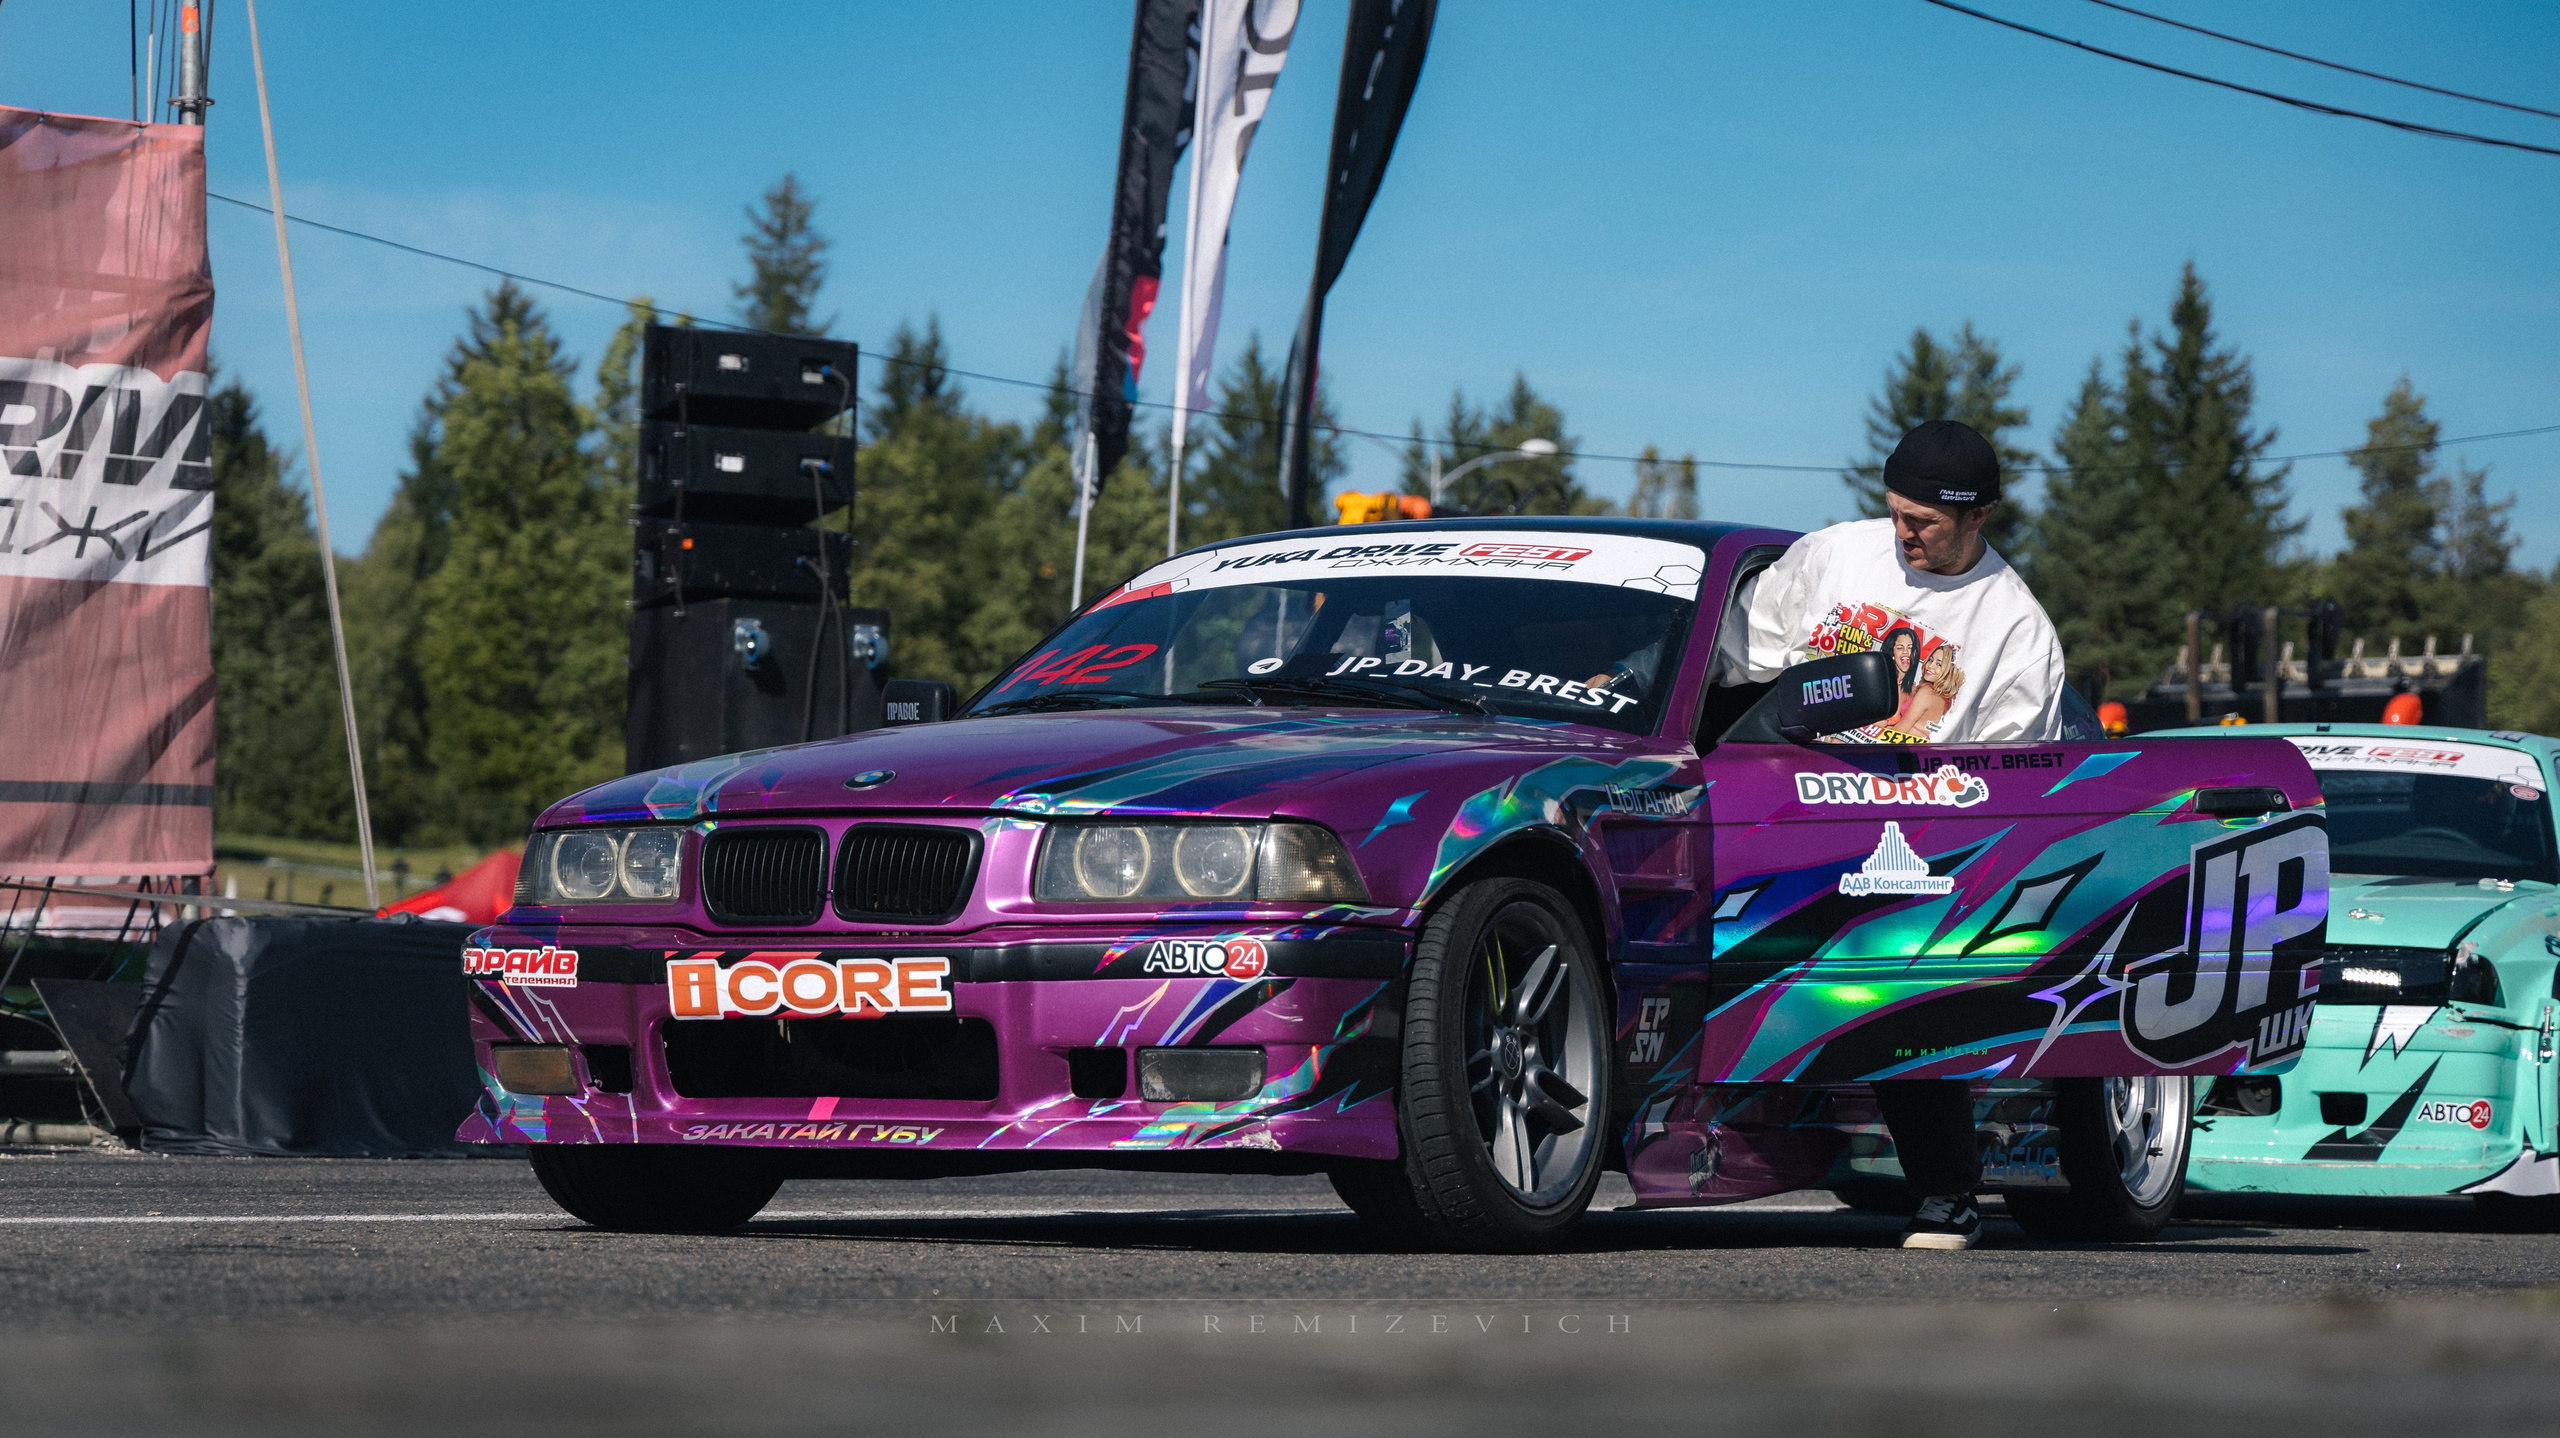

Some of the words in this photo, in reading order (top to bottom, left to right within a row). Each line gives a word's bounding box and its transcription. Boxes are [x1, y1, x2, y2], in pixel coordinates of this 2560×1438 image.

[1209, 549, 1326, 573] YUKA
[1315, 544, 1461, 560] DRIVE
[1463, 544, 1591, 561] FEST
[1839, 624, 1864, 647] FUN
[1863, 634, 1874, 648] &
[997, 644, 1159, 694] 142
[1326, 656, 1638, 714] JP_DAY_BREST
[1803, 675, 1853, 706] ЛЕВОЕ
[887, 702, 920, 721] ПРАВОЕ
[1922, 753, 2064, 772] JPDAY_BREST
[1842, 877, 1871, 891] АДВ
[1874, 878, 1951, 891] Консалтинг
[1895, 1048, 1912, 1057] ли
[1920, 1048, 1937, 1057] из
[1944, 1046, 1988, 1056] Китая
[683, 1121, 847, 1141] ЗАКАТАЙ
[848, 1123, 945, 1146] ГУБУ
